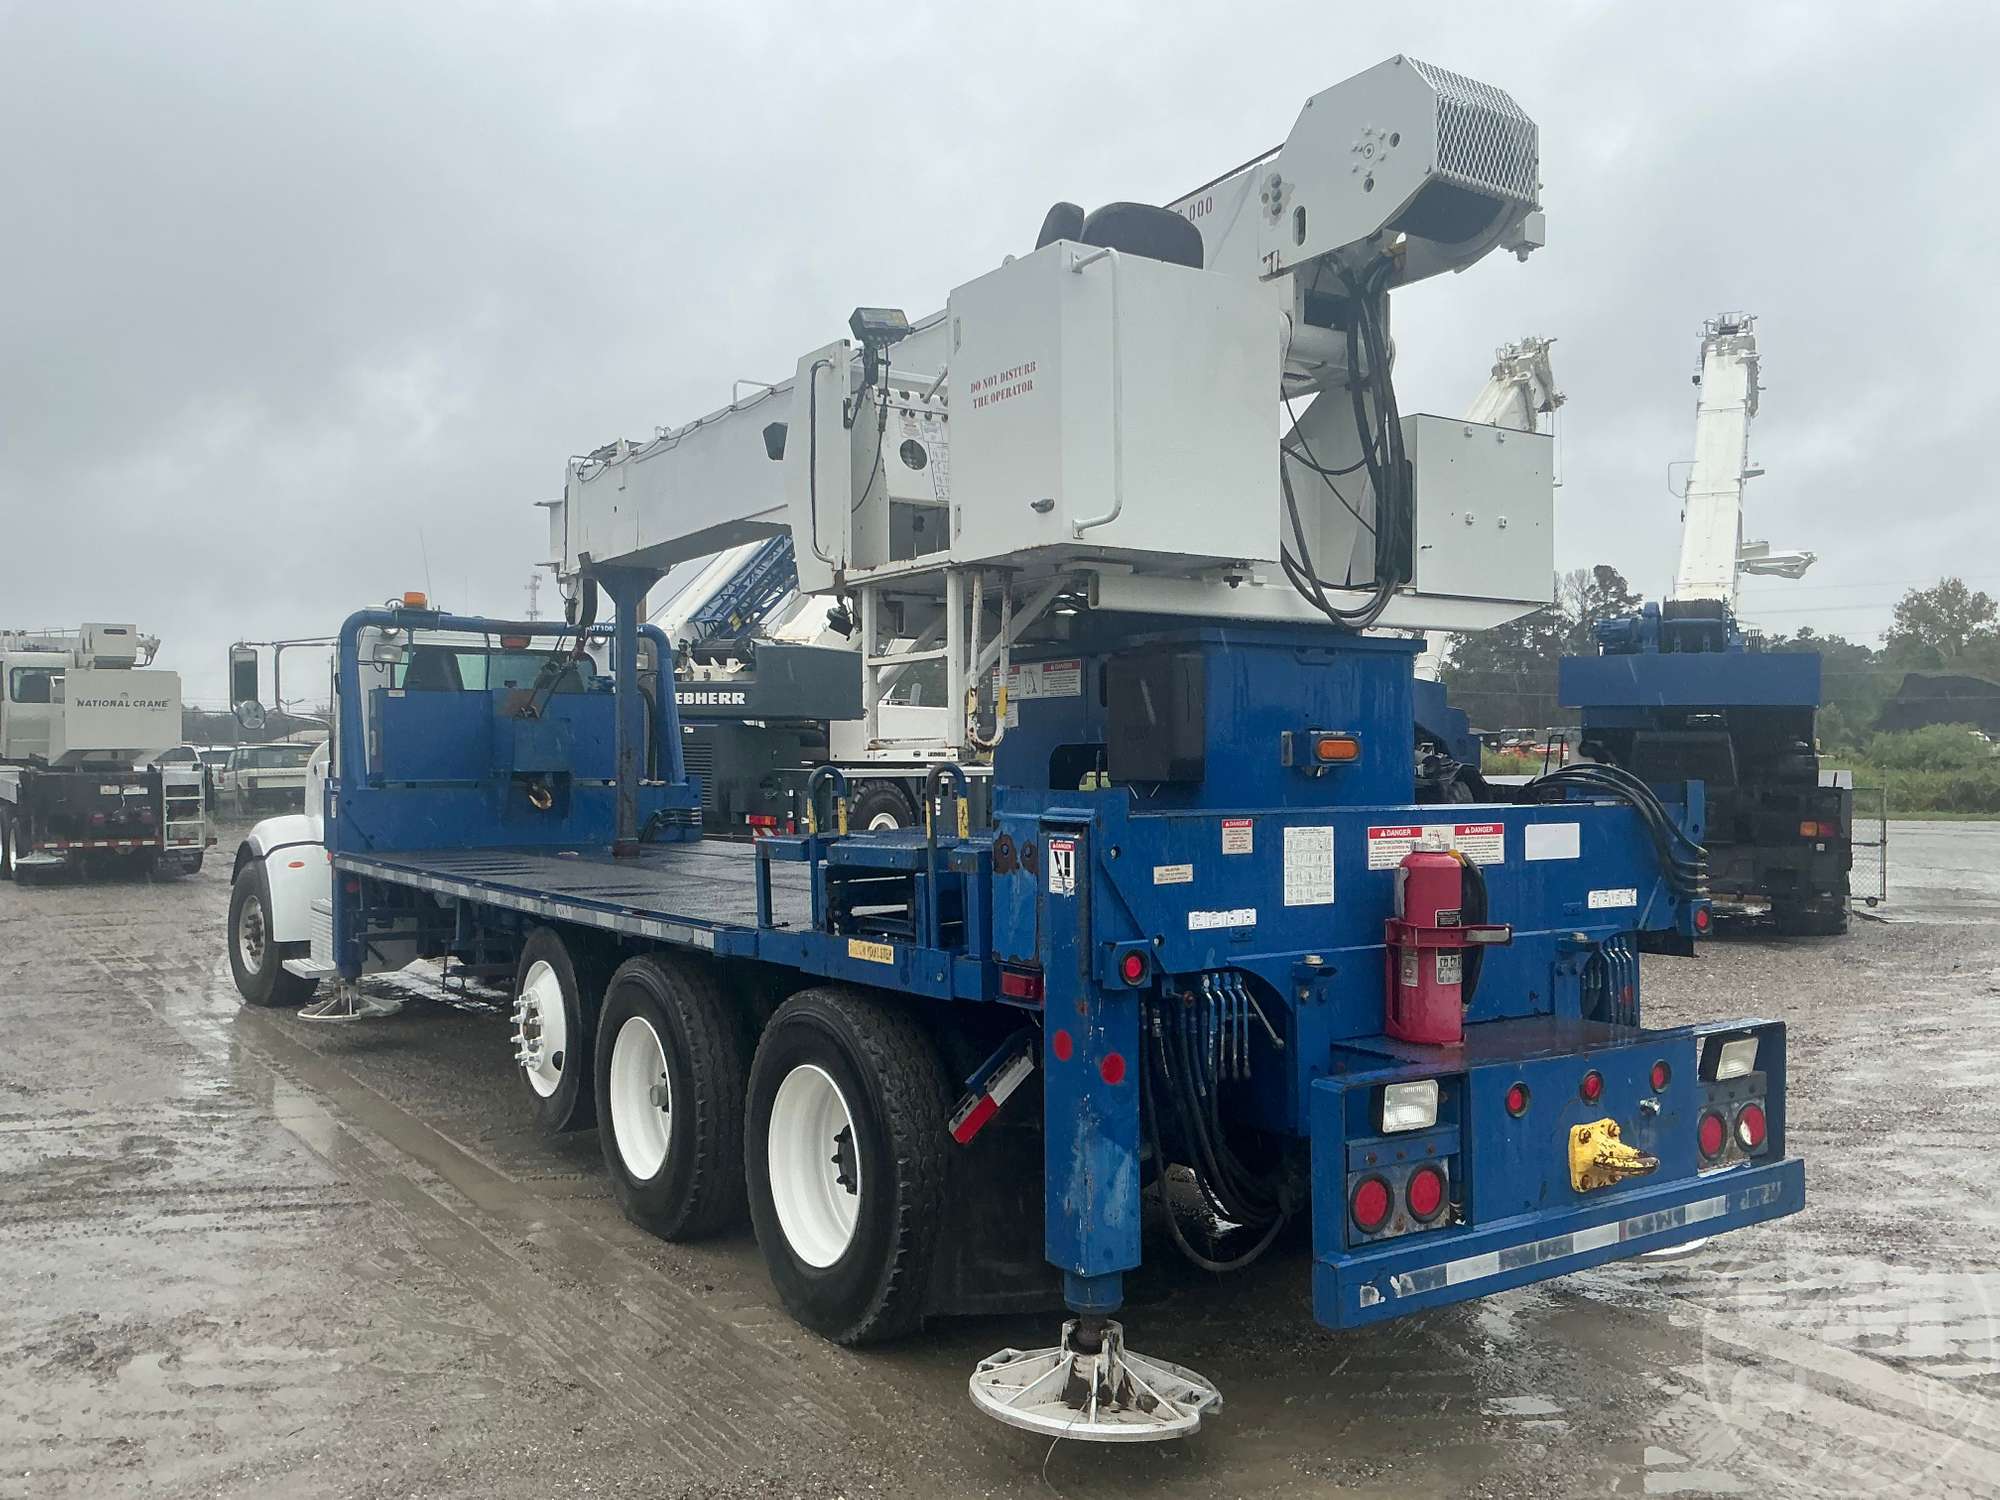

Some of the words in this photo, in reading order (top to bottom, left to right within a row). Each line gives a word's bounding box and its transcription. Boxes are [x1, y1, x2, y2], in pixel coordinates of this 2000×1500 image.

[970, 380, 981, 393] DO
[983, 374, 998, 389] NOT
[1000, 361, 1036, 383] DISTURB
[973, 394, 988, 409] THE
[990, 379, 1033, 403] OPERATOR
[77, 700, 130, 708] NATIONAL
[132, 700, 169, 708] CRANE
[1386, 829, 1411, 837] DANGER
[1471, 826, 1494, 834] DANGER
